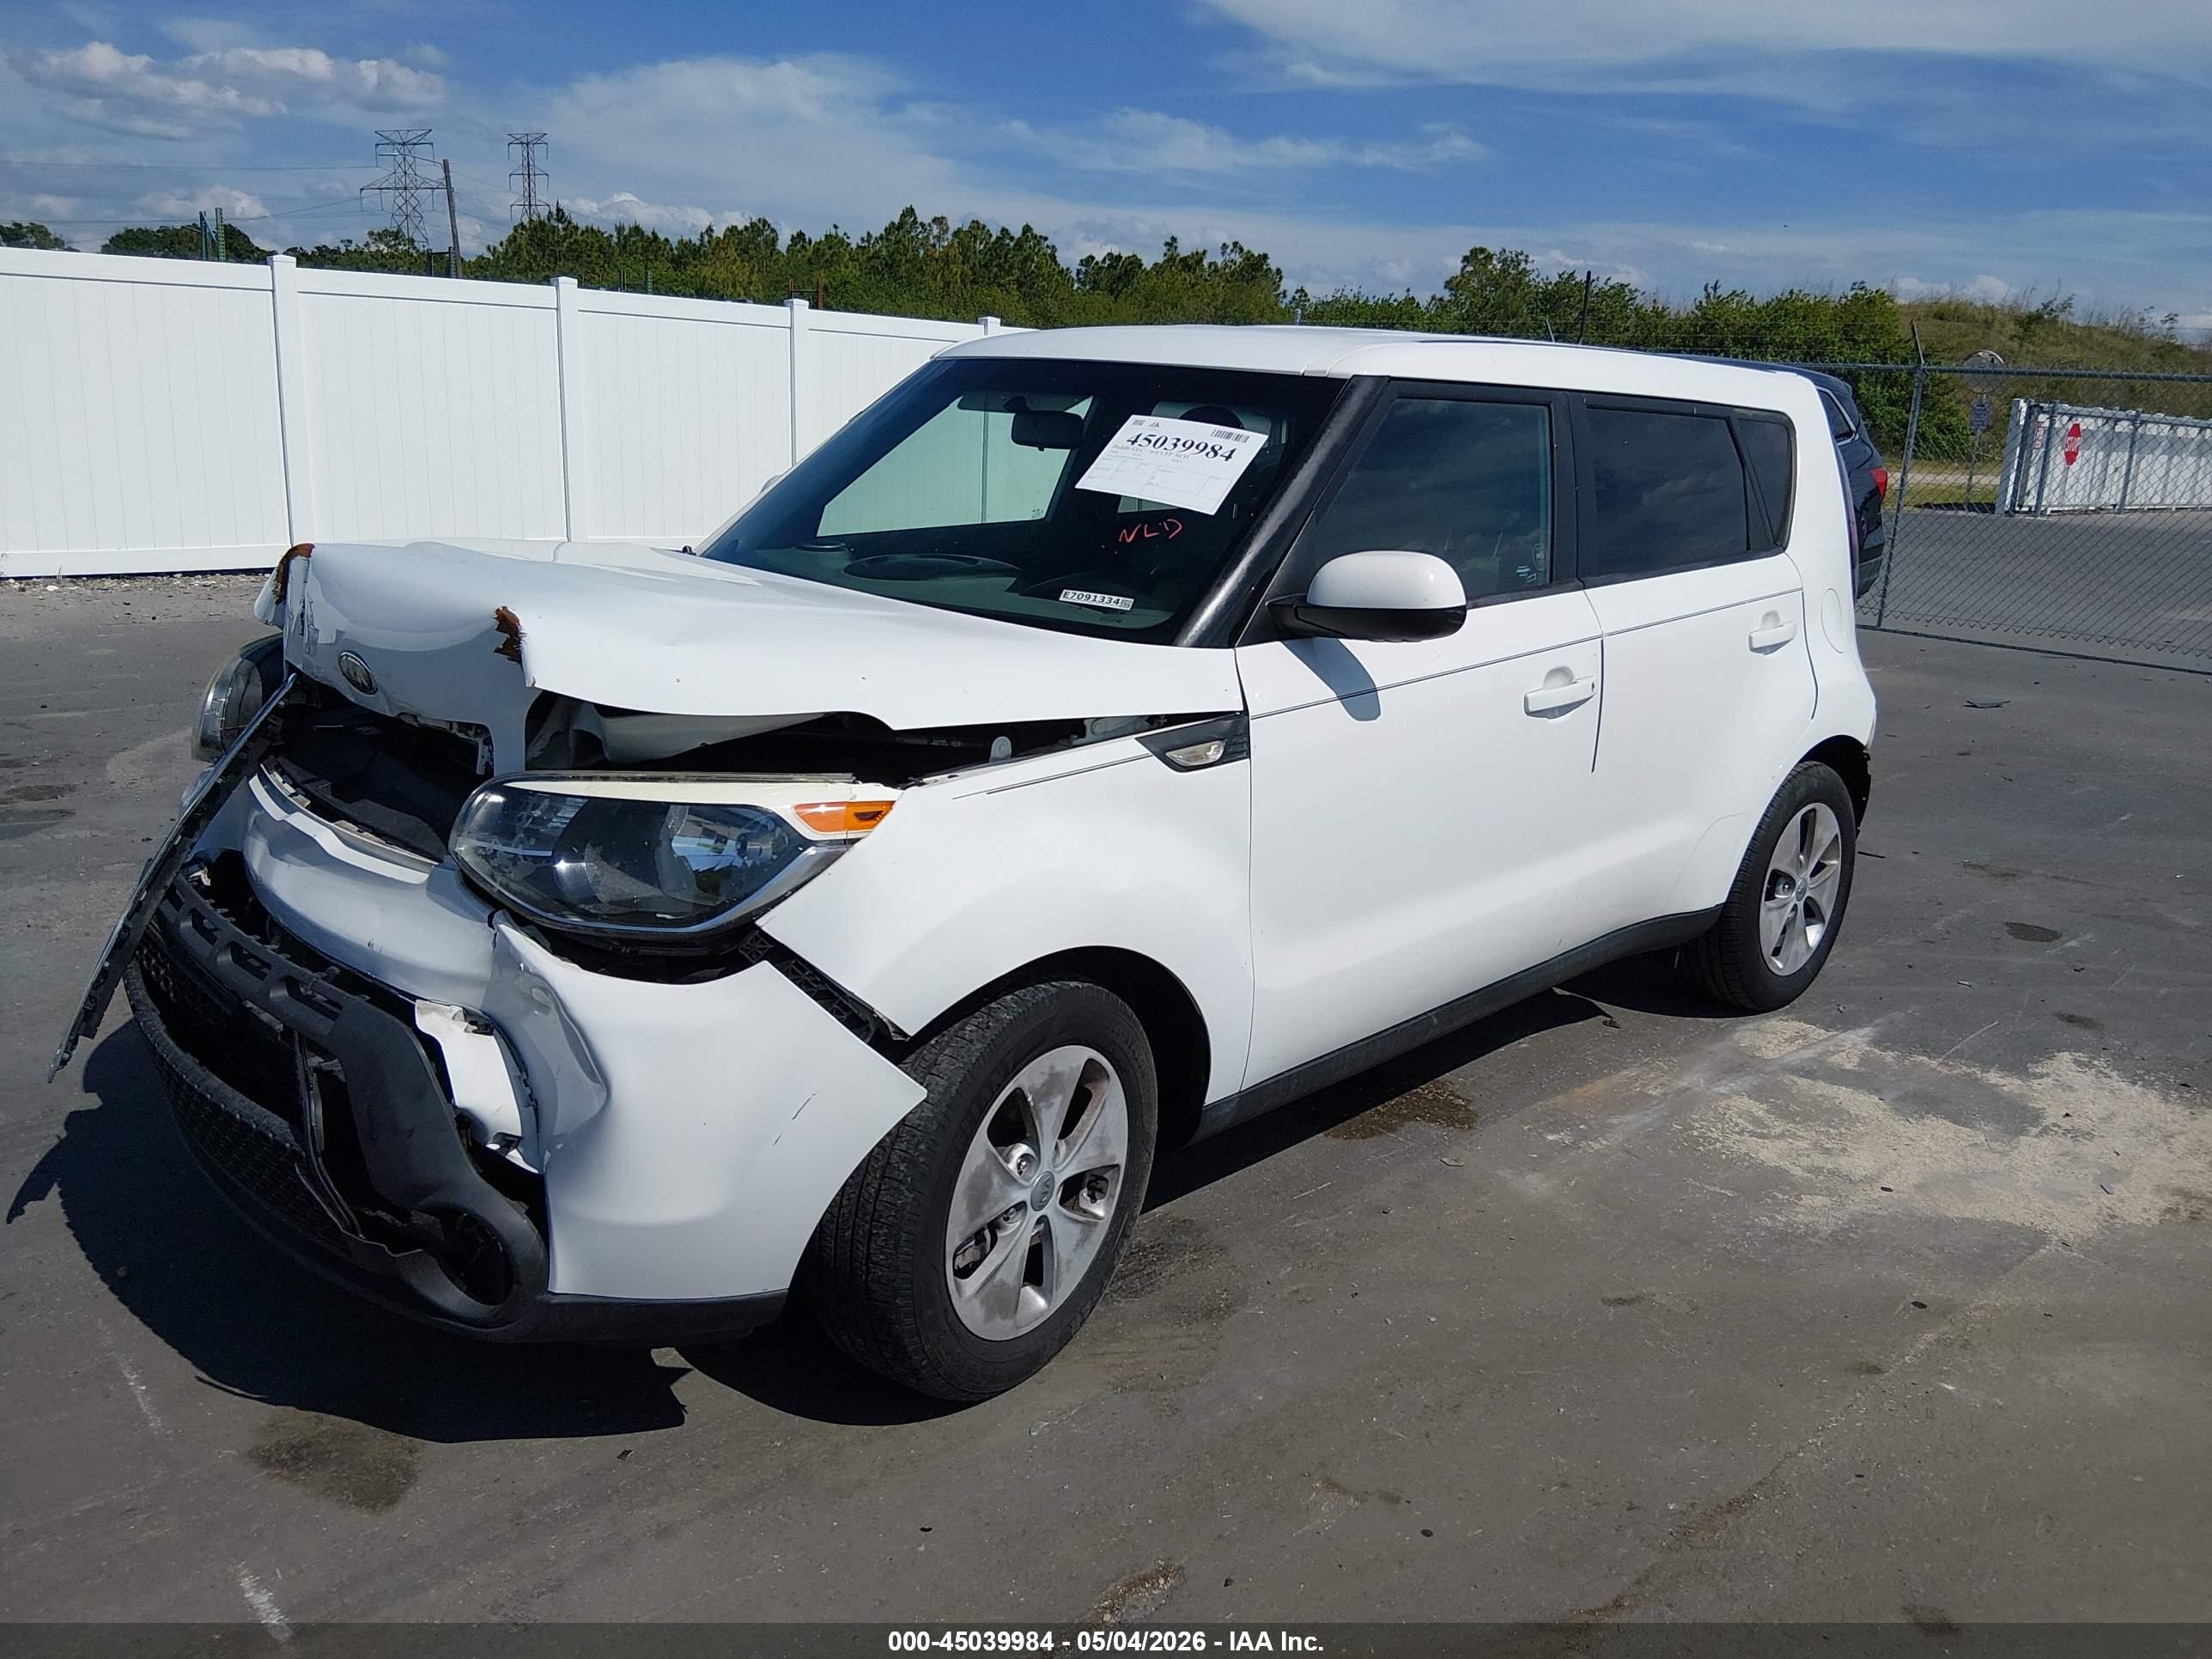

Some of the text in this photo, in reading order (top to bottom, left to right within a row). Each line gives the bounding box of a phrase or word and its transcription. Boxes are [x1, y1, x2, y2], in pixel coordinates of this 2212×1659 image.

[1127, 432, 1237, 462] 45039984
[2064, 436, 2081, 453] STOP
[1062, 591, 1121, 606] E7091334
